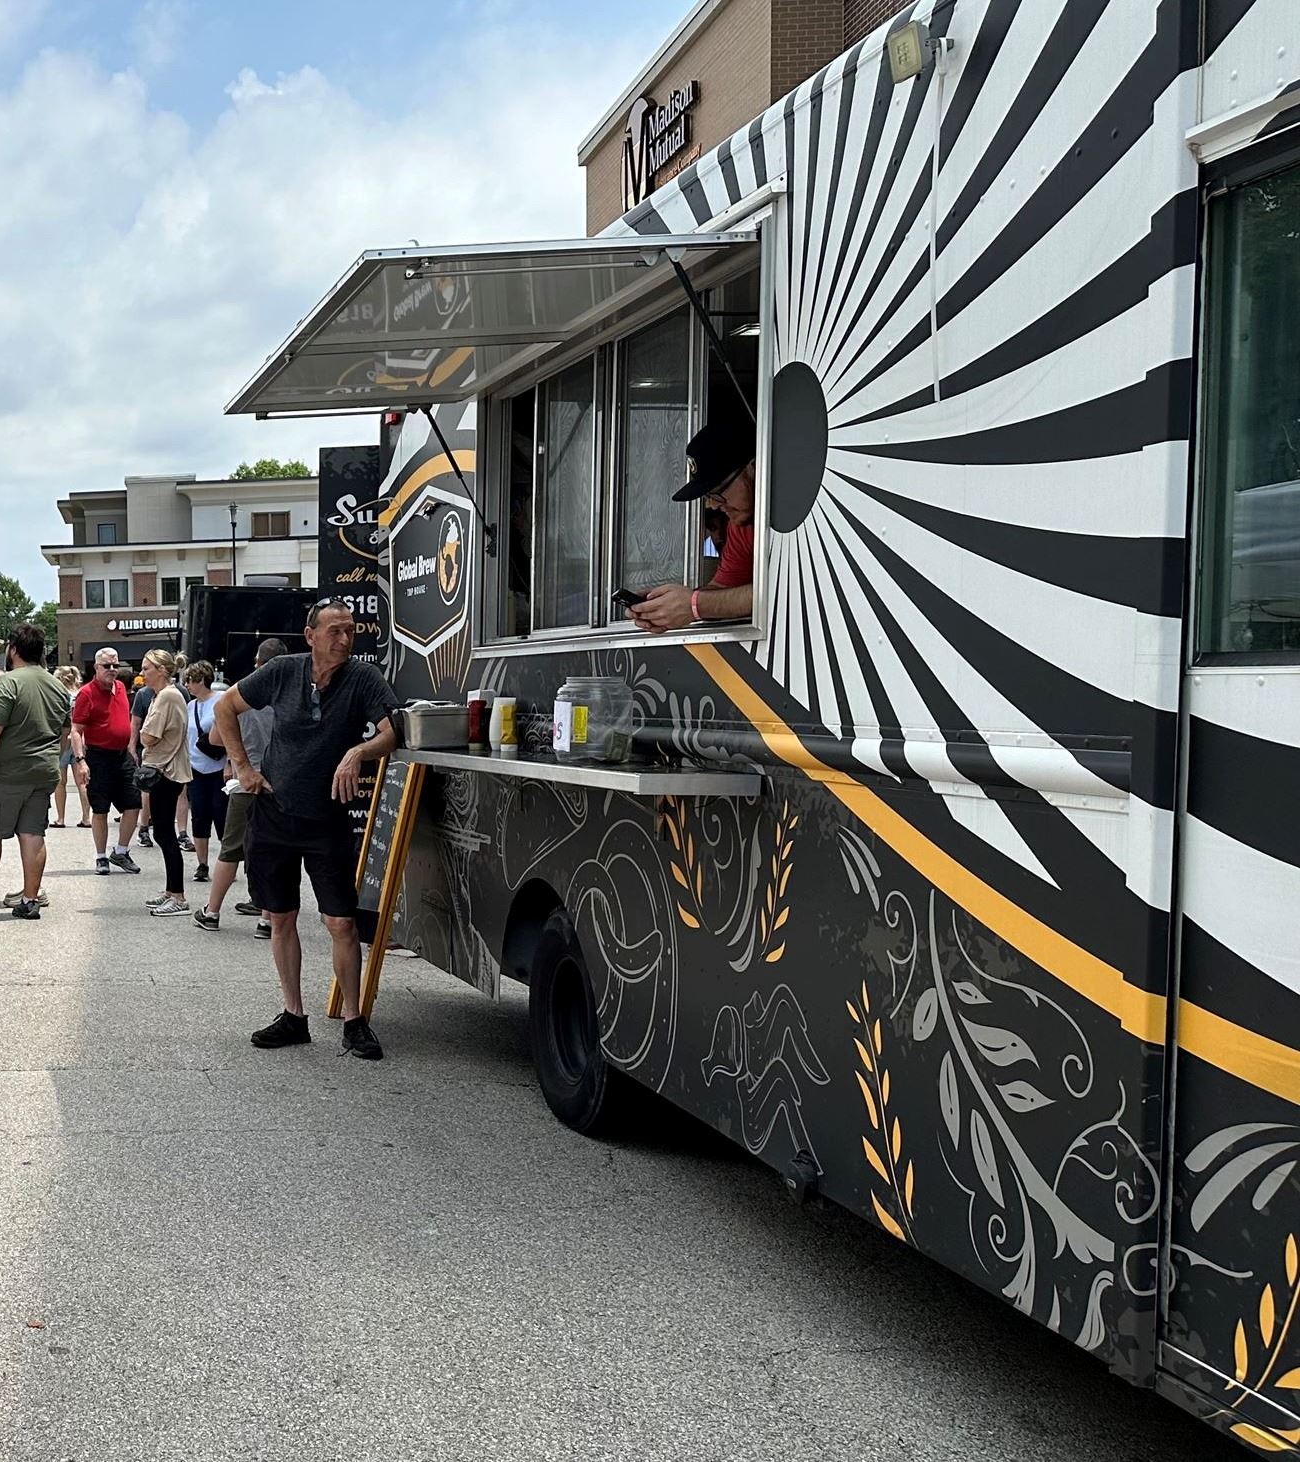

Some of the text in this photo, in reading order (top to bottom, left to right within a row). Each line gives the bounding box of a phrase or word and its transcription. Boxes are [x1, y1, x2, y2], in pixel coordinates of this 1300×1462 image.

[649, 80, 695, 144] Madison
[649, 113, 686, 177] Mutual
[336, 567, 365, 583] call
[398, 555, 436, 582] Global Brew
[118, 619, 143, 630] ALIBI
